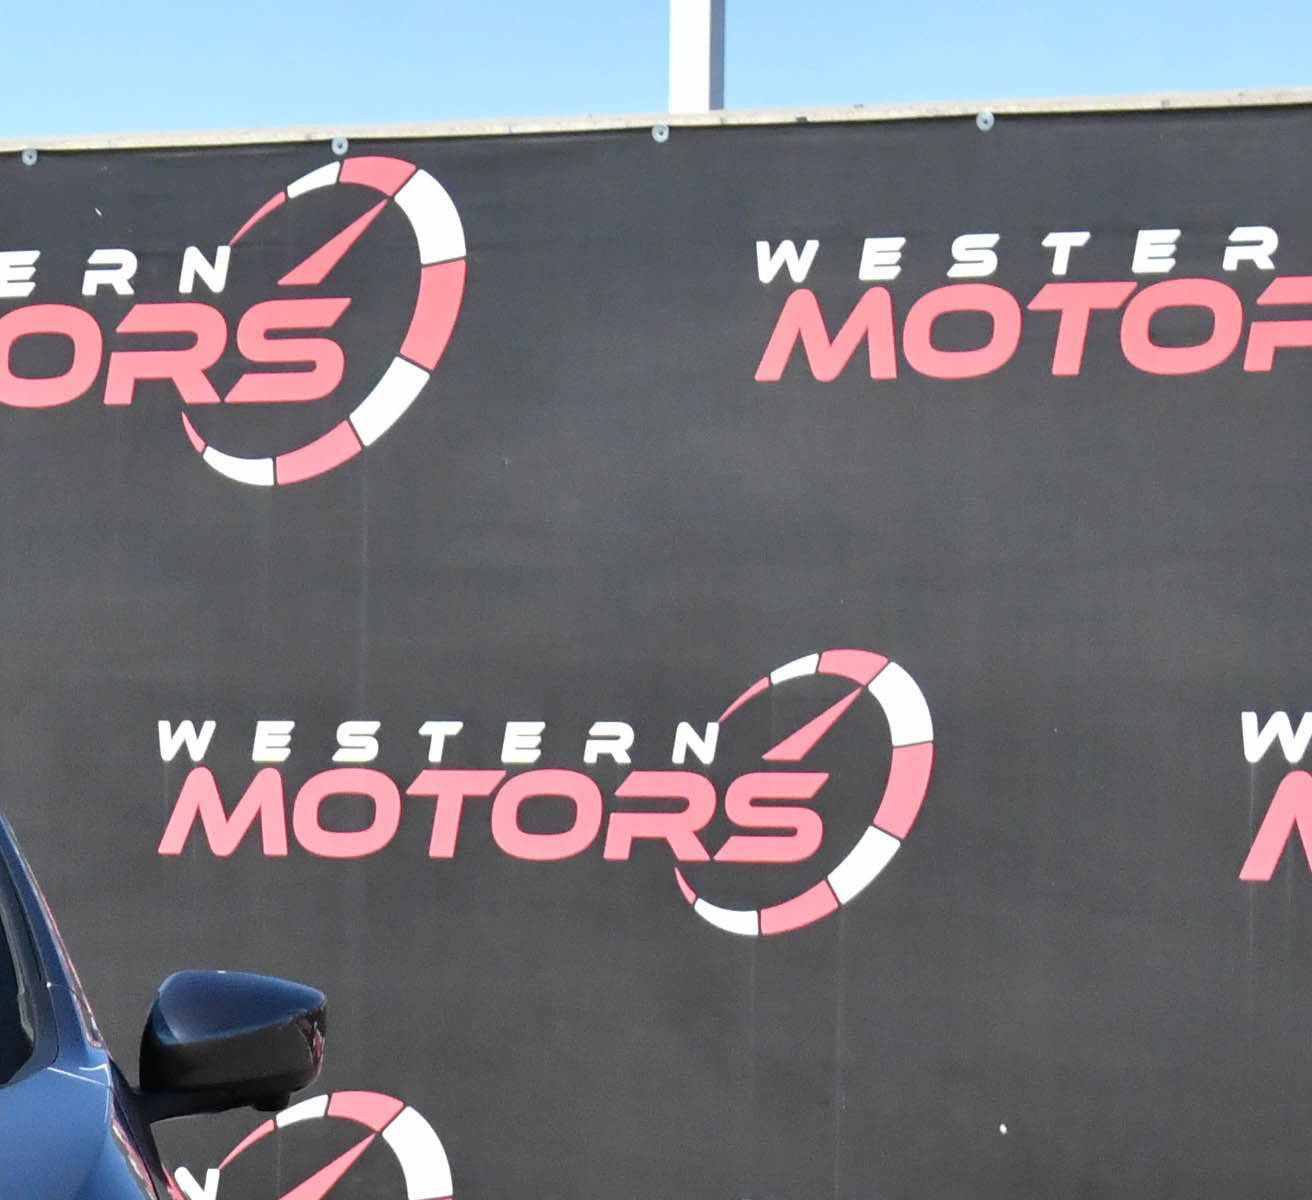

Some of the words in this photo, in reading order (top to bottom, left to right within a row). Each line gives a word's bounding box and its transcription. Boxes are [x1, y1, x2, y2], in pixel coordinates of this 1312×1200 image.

[755, 225, 1280, 285] WESTER
[157, 719, 720, 766] WESTERN
[157, 766, 830, 863] MOTORS
